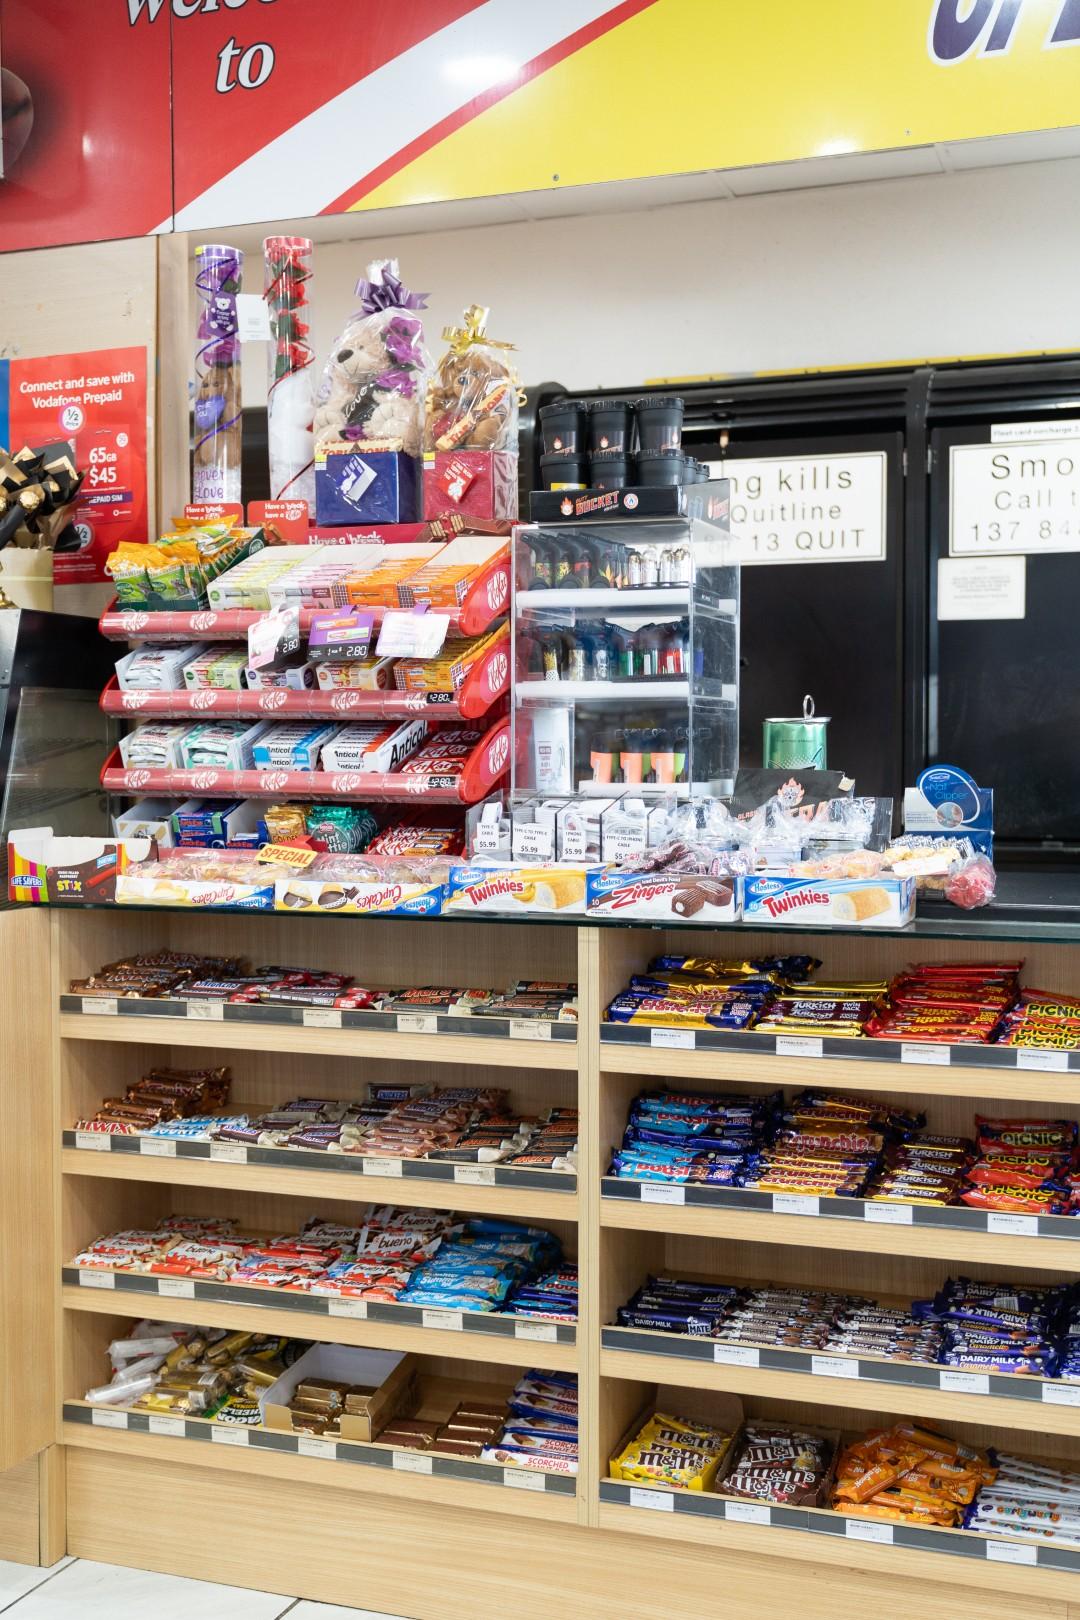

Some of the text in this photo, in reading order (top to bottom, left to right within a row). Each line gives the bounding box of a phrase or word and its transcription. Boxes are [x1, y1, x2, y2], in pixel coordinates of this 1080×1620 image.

[216, 37, 275, 93] to
[20, 371, 135, 394] Connect and save with
[83, 389, 122, 406] Prepaid
[89, 465, 117, 487] $45
[778, 466, 853, 492] kills
[995, 488, 1053, 511] Call
[731, 502, 841, 524] Quitline
[970, 521, 1021, 542] 137
[308, 535, 338, 545] Have
[752, 532, 780, 552] 13
[795, 529, 865, 551] QUIT
[389, 719, 429, 770] Anticol
[479, 841, 497, 849] $5.99
[520, 845, 539, 854] $5.99
[564, 848, 583, 856] $5.99
[260, 847, 312, 866] SPECIAL
[457, 871, 482, 882] Hostess
[56, 879, 82, 892] STIX
[596, 878, 621, 890] Hostess
[754, 882, 780, 893] Hostess
[356, 885, 402, 910] CupCakes
[465, 878, 524, 905] Twinkies
[611, 883, 674, 910] Zingers
[405, 897, 432, 910] Hostess
[592, 898, 600, 906] 10
[762, 889, 830, 918] Twinkies
[1001, 1132, 1063, 1146] PICNIC
[908, 1148, 954, 1159] TURKISH
[911, 1160, 957, 1175] TURKISH
[896, 1174, 942, 1185] TURKISH
[401, 1215, 437, 1226] bueno
[378, 1236, 413, 1249] bueno
[966, 1288, 994, 1297] DAIRY
[853, 1315, 904, 1325] DAIRY MILK
[975, 1307, 1028, 1324] DAIRY MILK
[634, 1318, 711, 1334] DAIRY MILK MATE
[960, 1354, 1016, 1365] DAIRY MILK
[527, 1457, 569, 1468] SCORCHED
